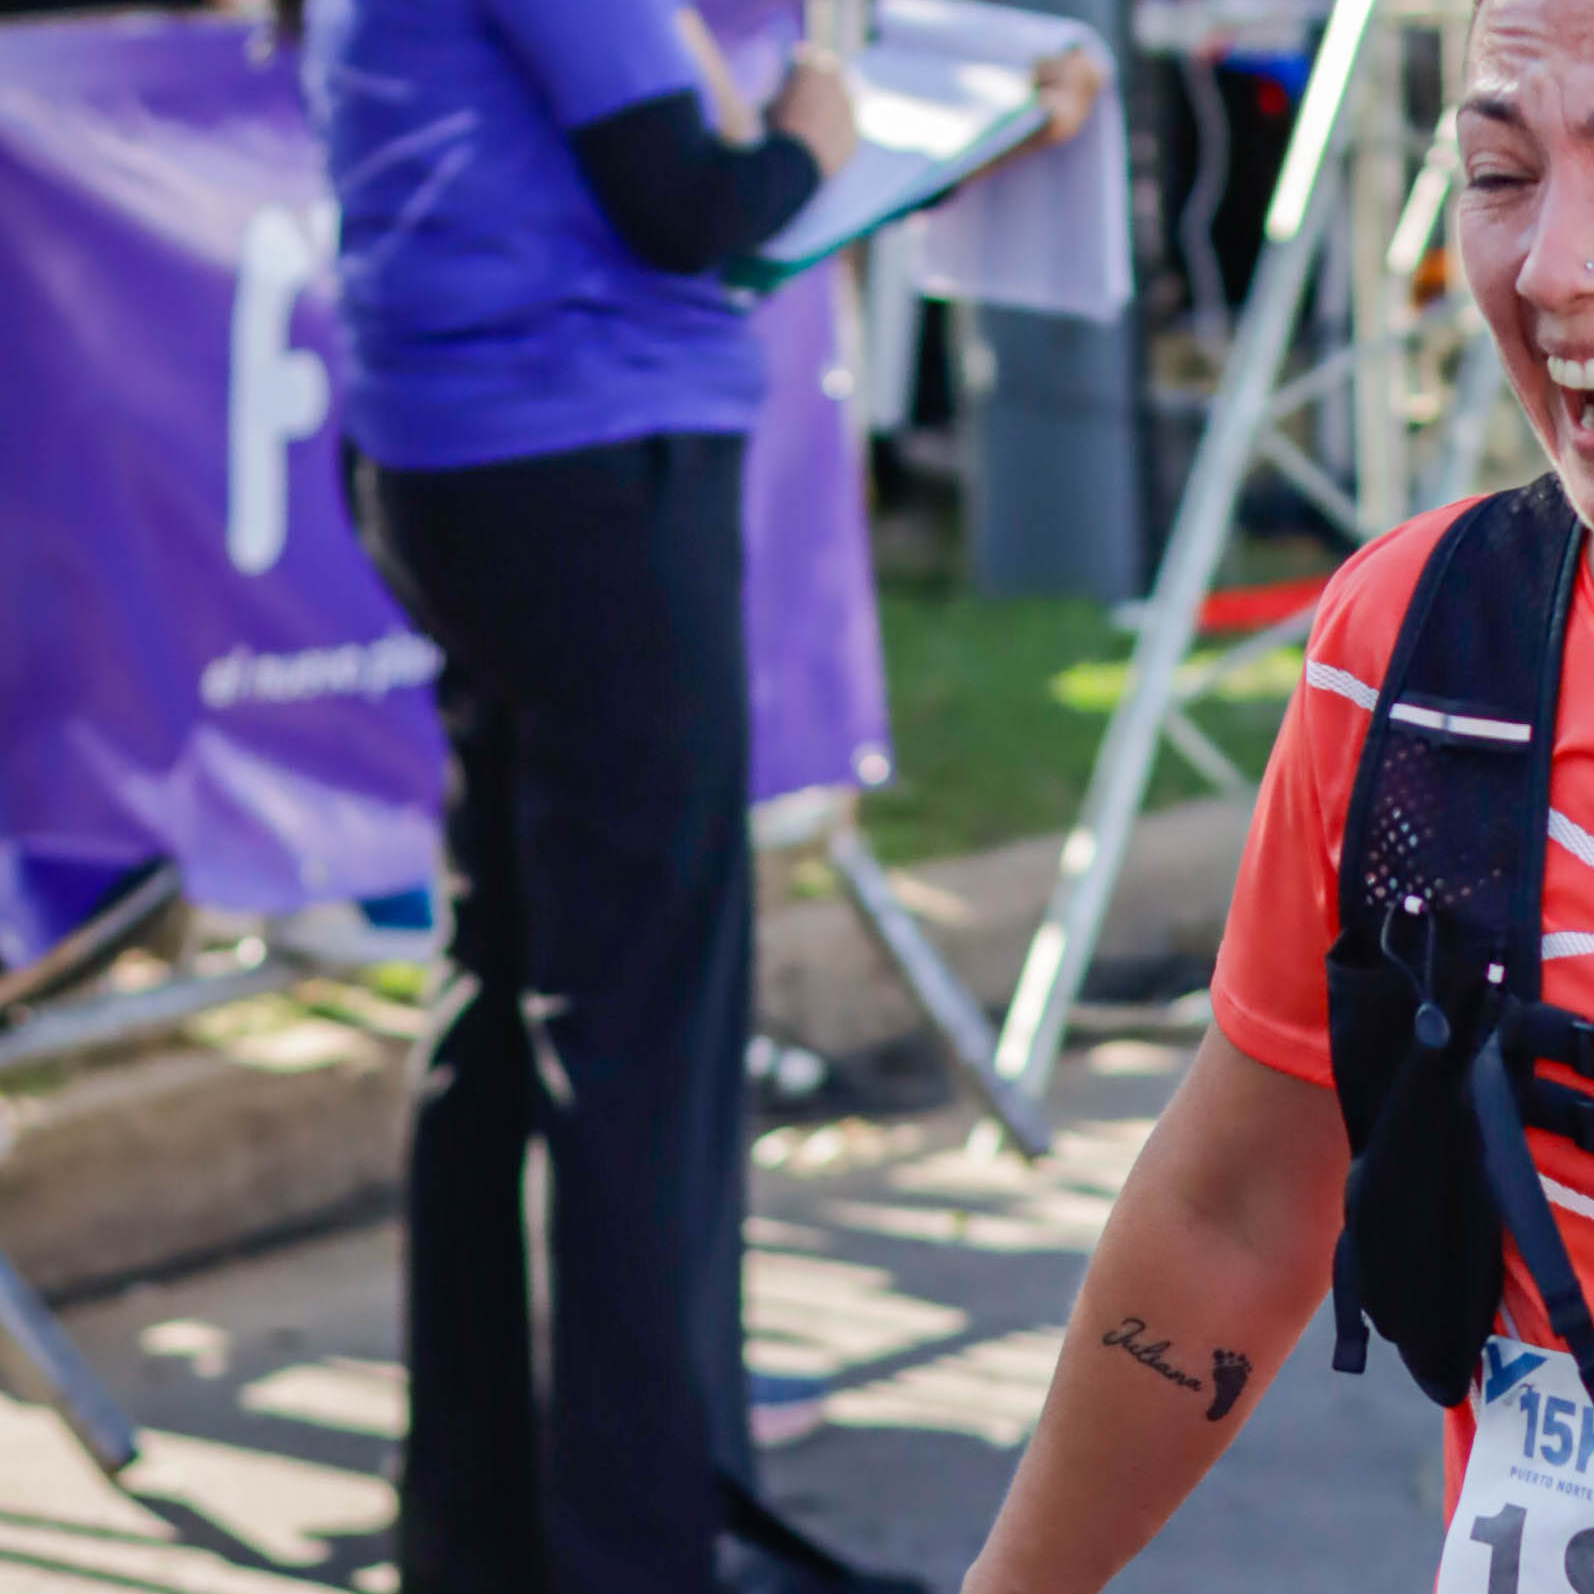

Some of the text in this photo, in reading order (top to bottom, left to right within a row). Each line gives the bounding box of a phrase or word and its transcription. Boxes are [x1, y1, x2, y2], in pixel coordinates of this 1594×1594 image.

[1102, 1317, 1202, 1392] Juliana
[1510, 1465, 1554, 1489] PUERTO
[1556, 1480, 1593, 1502] NORTE
